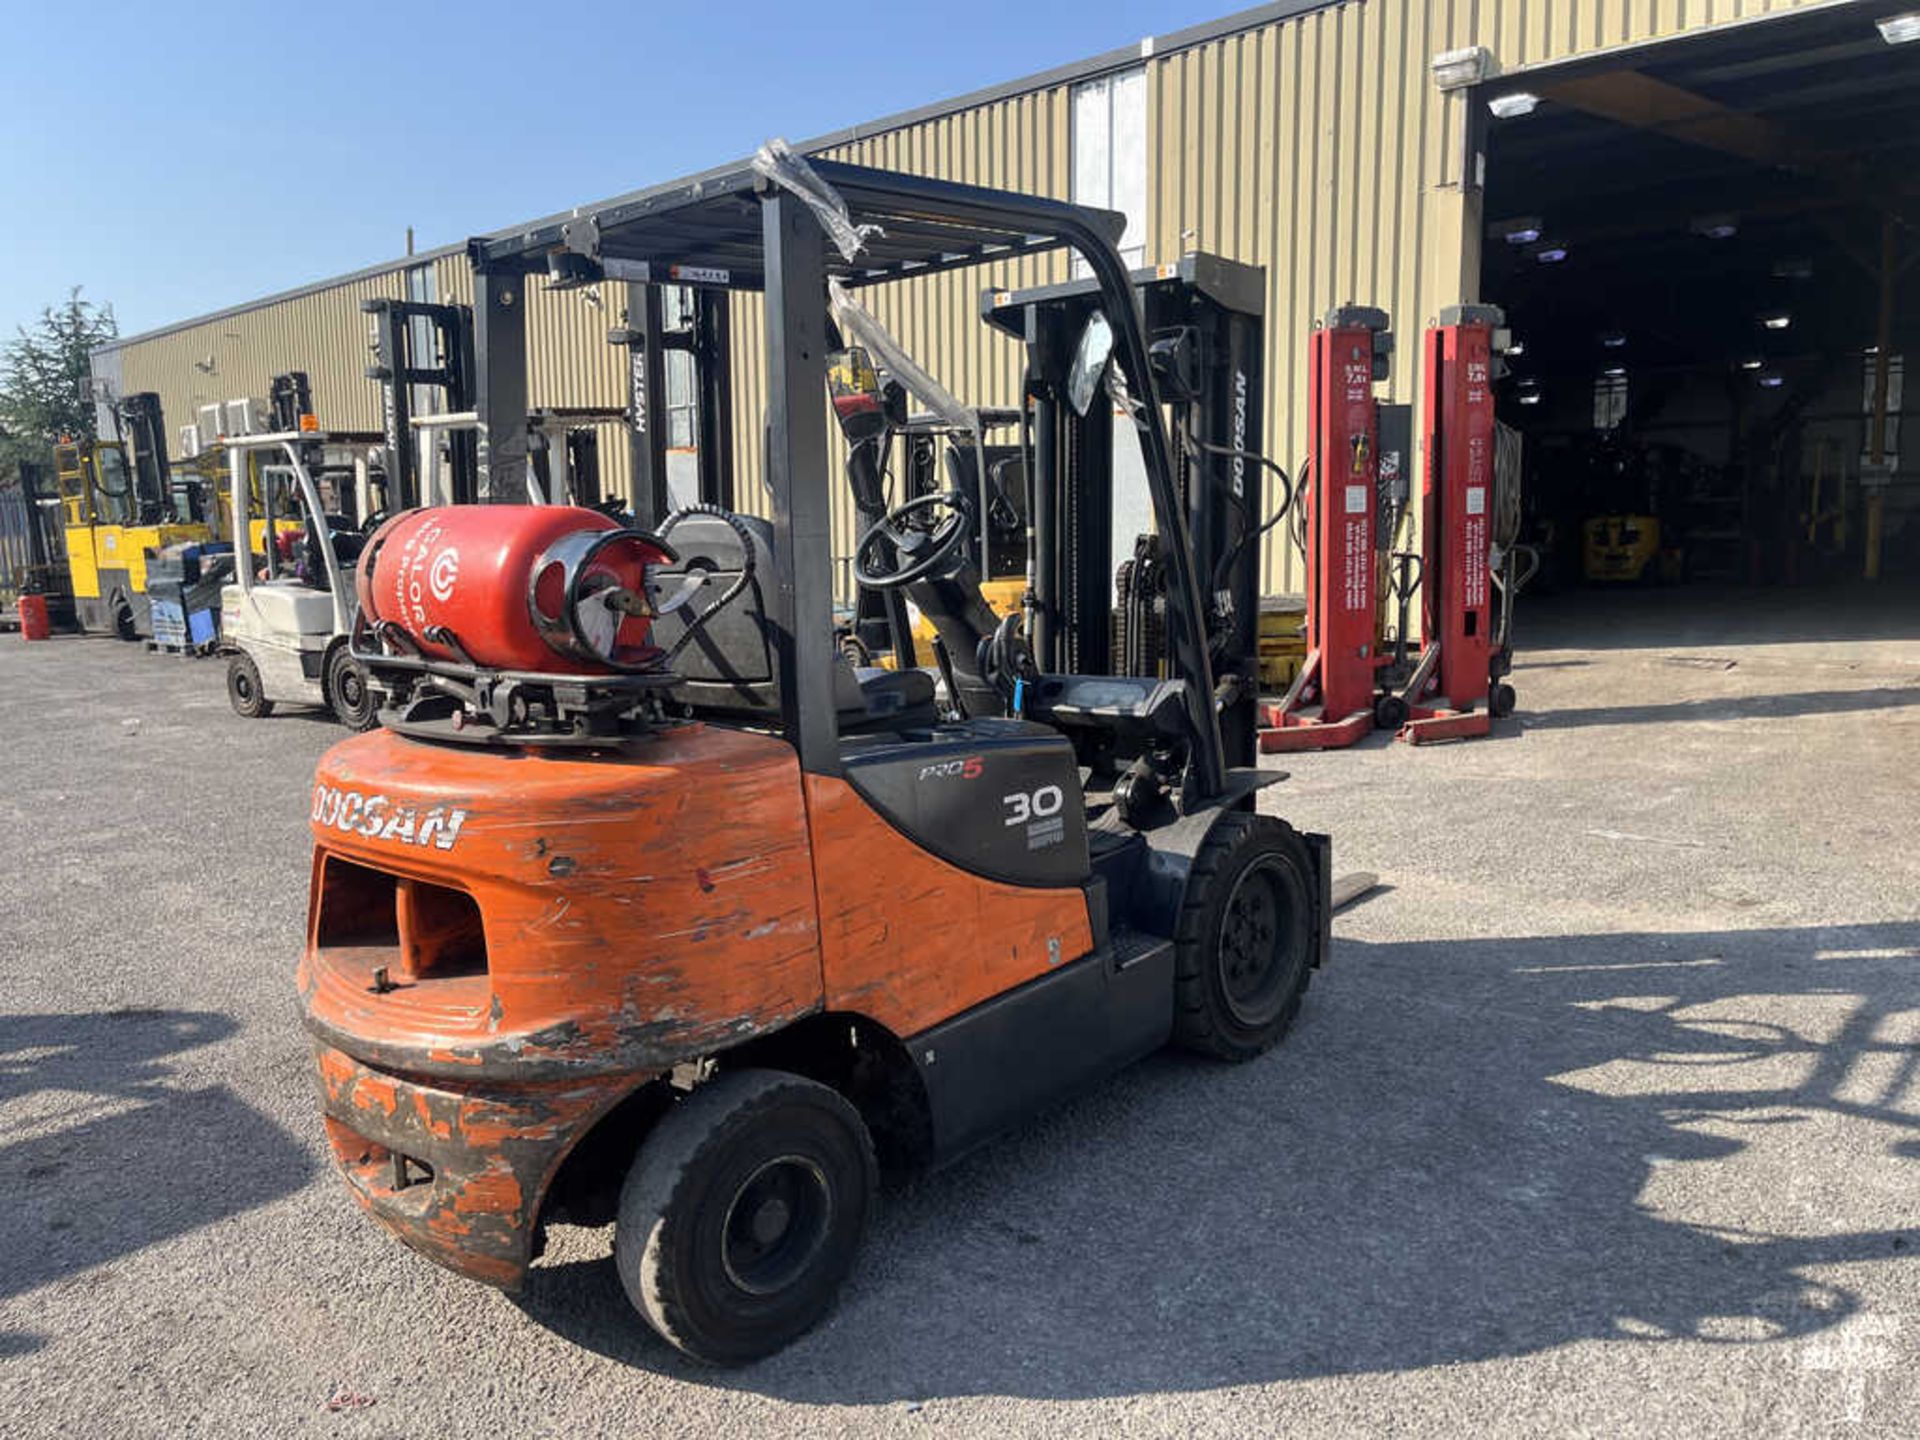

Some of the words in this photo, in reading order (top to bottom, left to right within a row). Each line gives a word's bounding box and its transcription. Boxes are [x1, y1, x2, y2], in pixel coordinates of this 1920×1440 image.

[1233, 370, 1246, 498] DOOSAN
[409, 527, 442, 624] CALOR
[1003, 785, 1063, 826] 30
